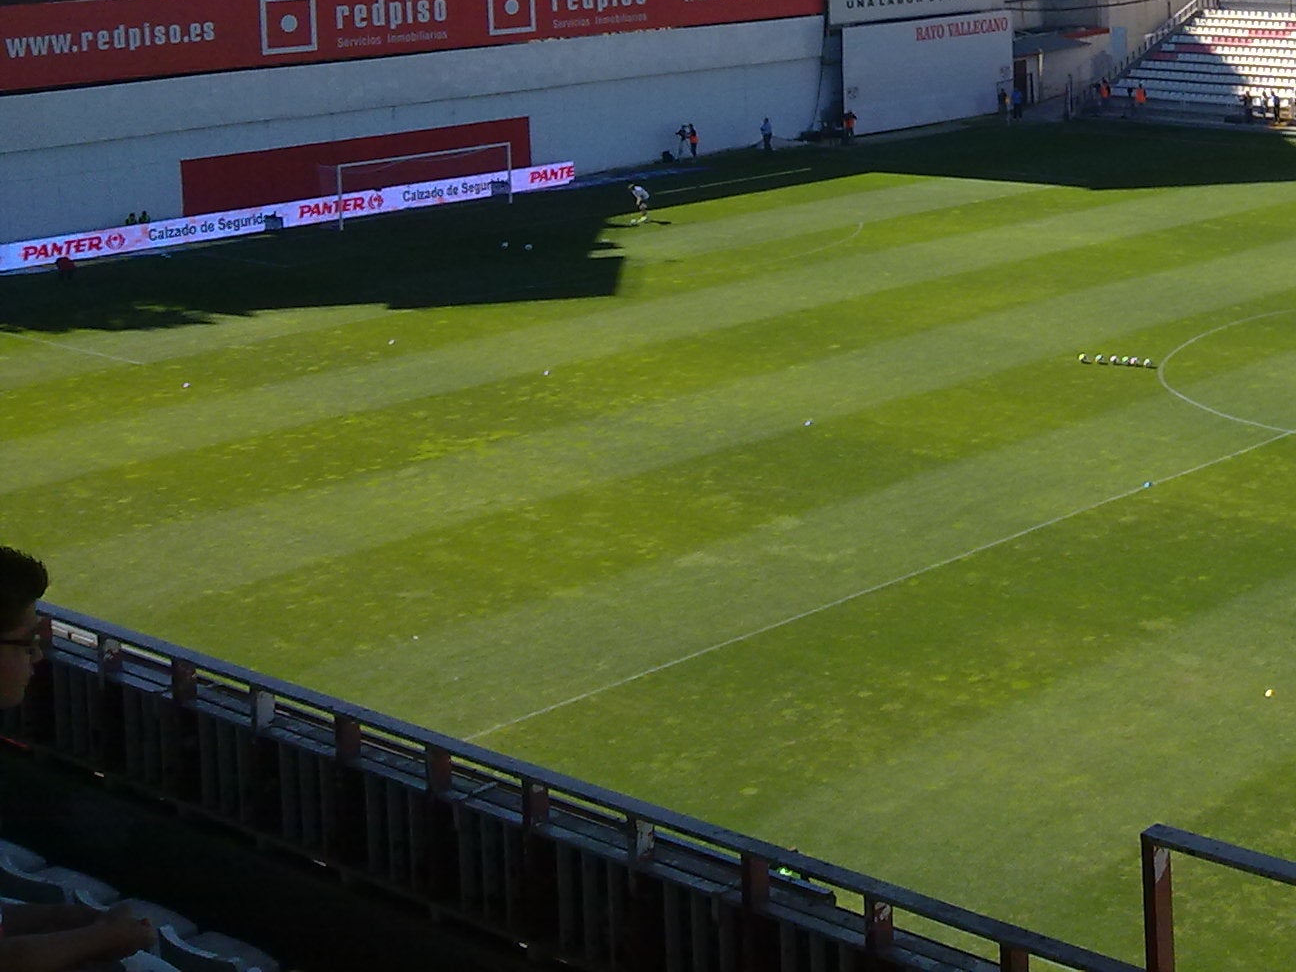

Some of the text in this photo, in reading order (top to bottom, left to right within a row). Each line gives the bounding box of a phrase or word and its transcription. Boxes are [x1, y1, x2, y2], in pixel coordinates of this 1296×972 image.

[846, 0, 875, 9] UNA
[5, 22, 215, 58] www.redpiso.es
[916, 17, 1008, 41] RAYO VALLECANO
[299, 196, 365, 218] PANTER
[403, 186, 443, 202] Calzado
[446, 184, 458, 196] de
[23, 236, 102, 260] PANTER
[149, 224, 196, 241] Calzado
[200, 221, 215, 233] de
